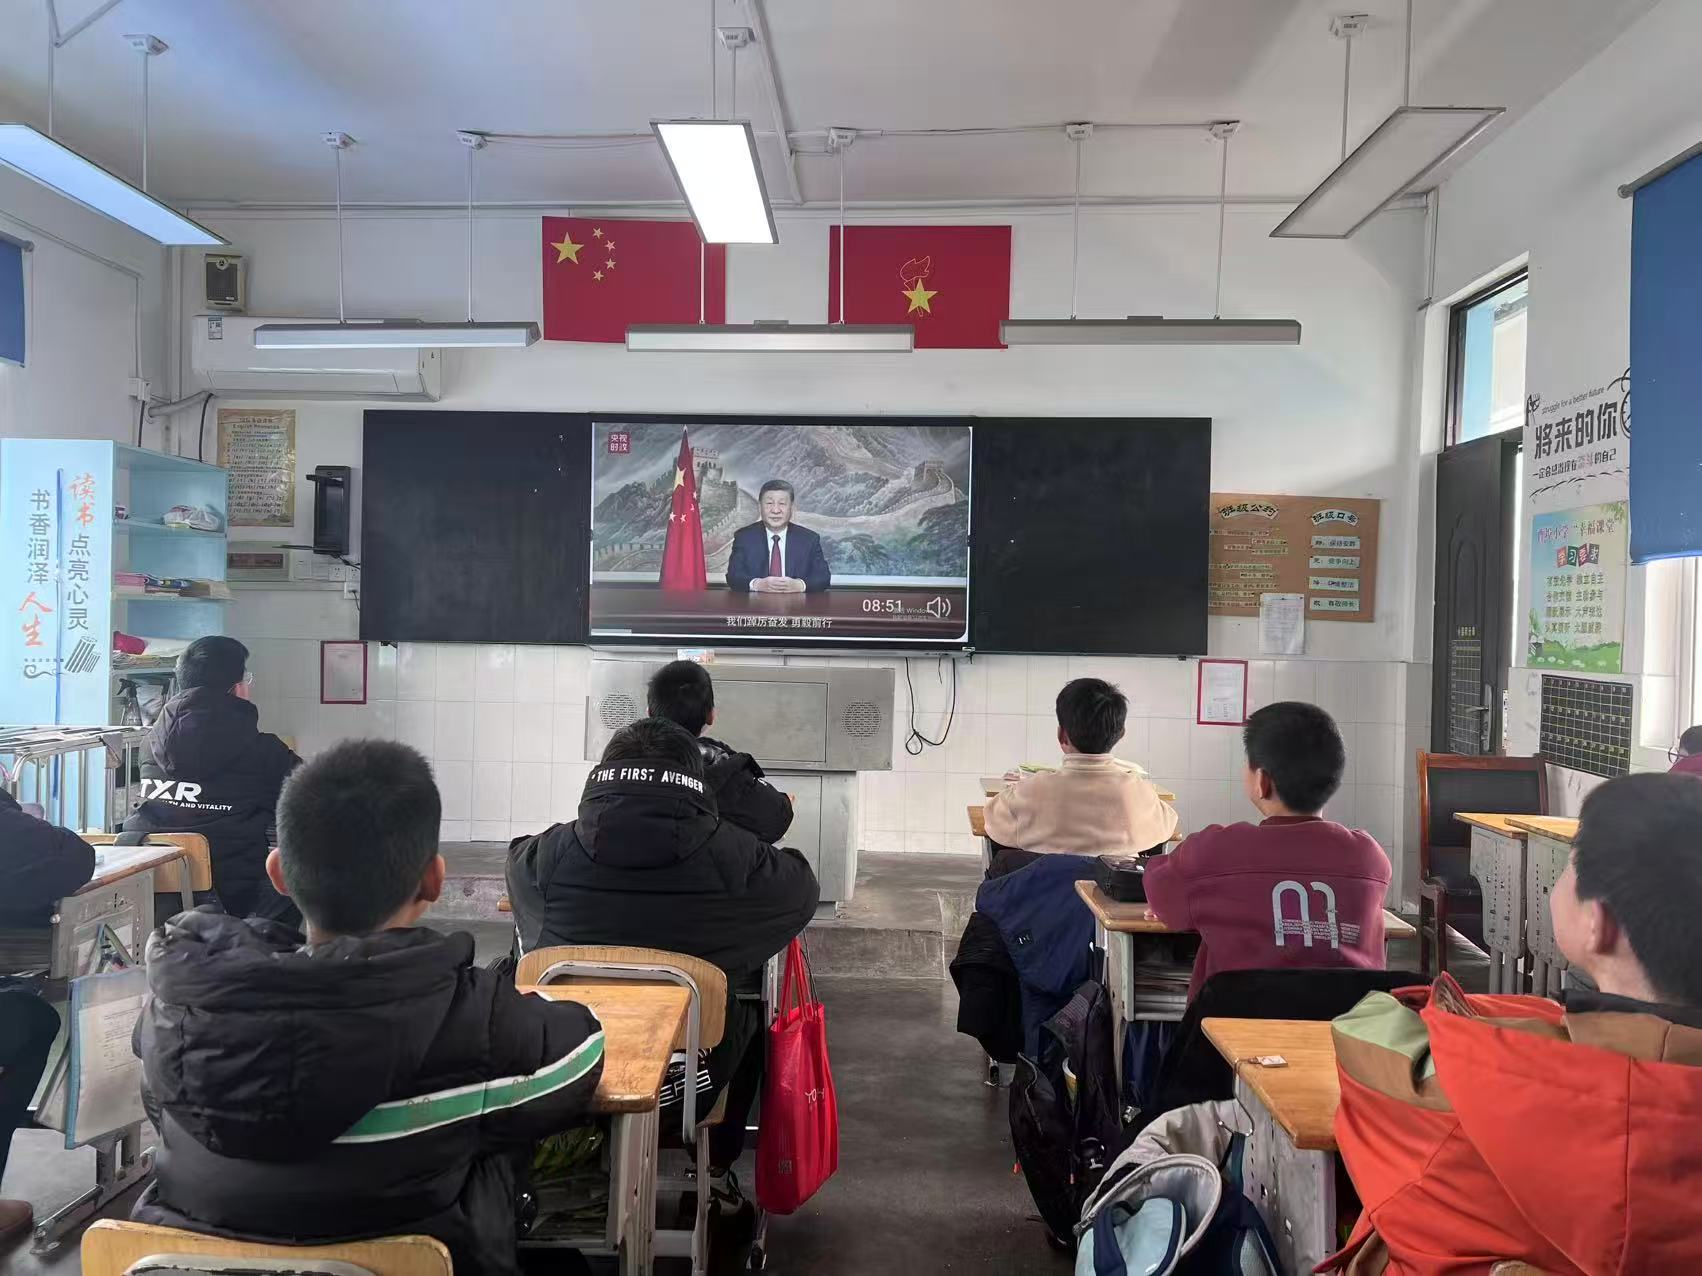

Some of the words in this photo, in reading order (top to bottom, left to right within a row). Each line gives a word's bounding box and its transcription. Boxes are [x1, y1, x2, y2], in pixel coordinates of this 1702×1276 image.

[1220, 503, 1277, 517] 班级公约
[1312, 511, 1358, 523] 班级口号
[1557, 546, 1599, 566] 学习要求
[862, 599, 902, 613] 08:51
[727, 616, 788, 628] 我们踔厉奋发
[791, 616, 833, 629] 勇毅前行
[597, 768, 616, 782] THE
[620, 767, 655, 781] FIRST
[180, 801, 197, 809] AND
[197, 803, 233, 811] VITALITY
